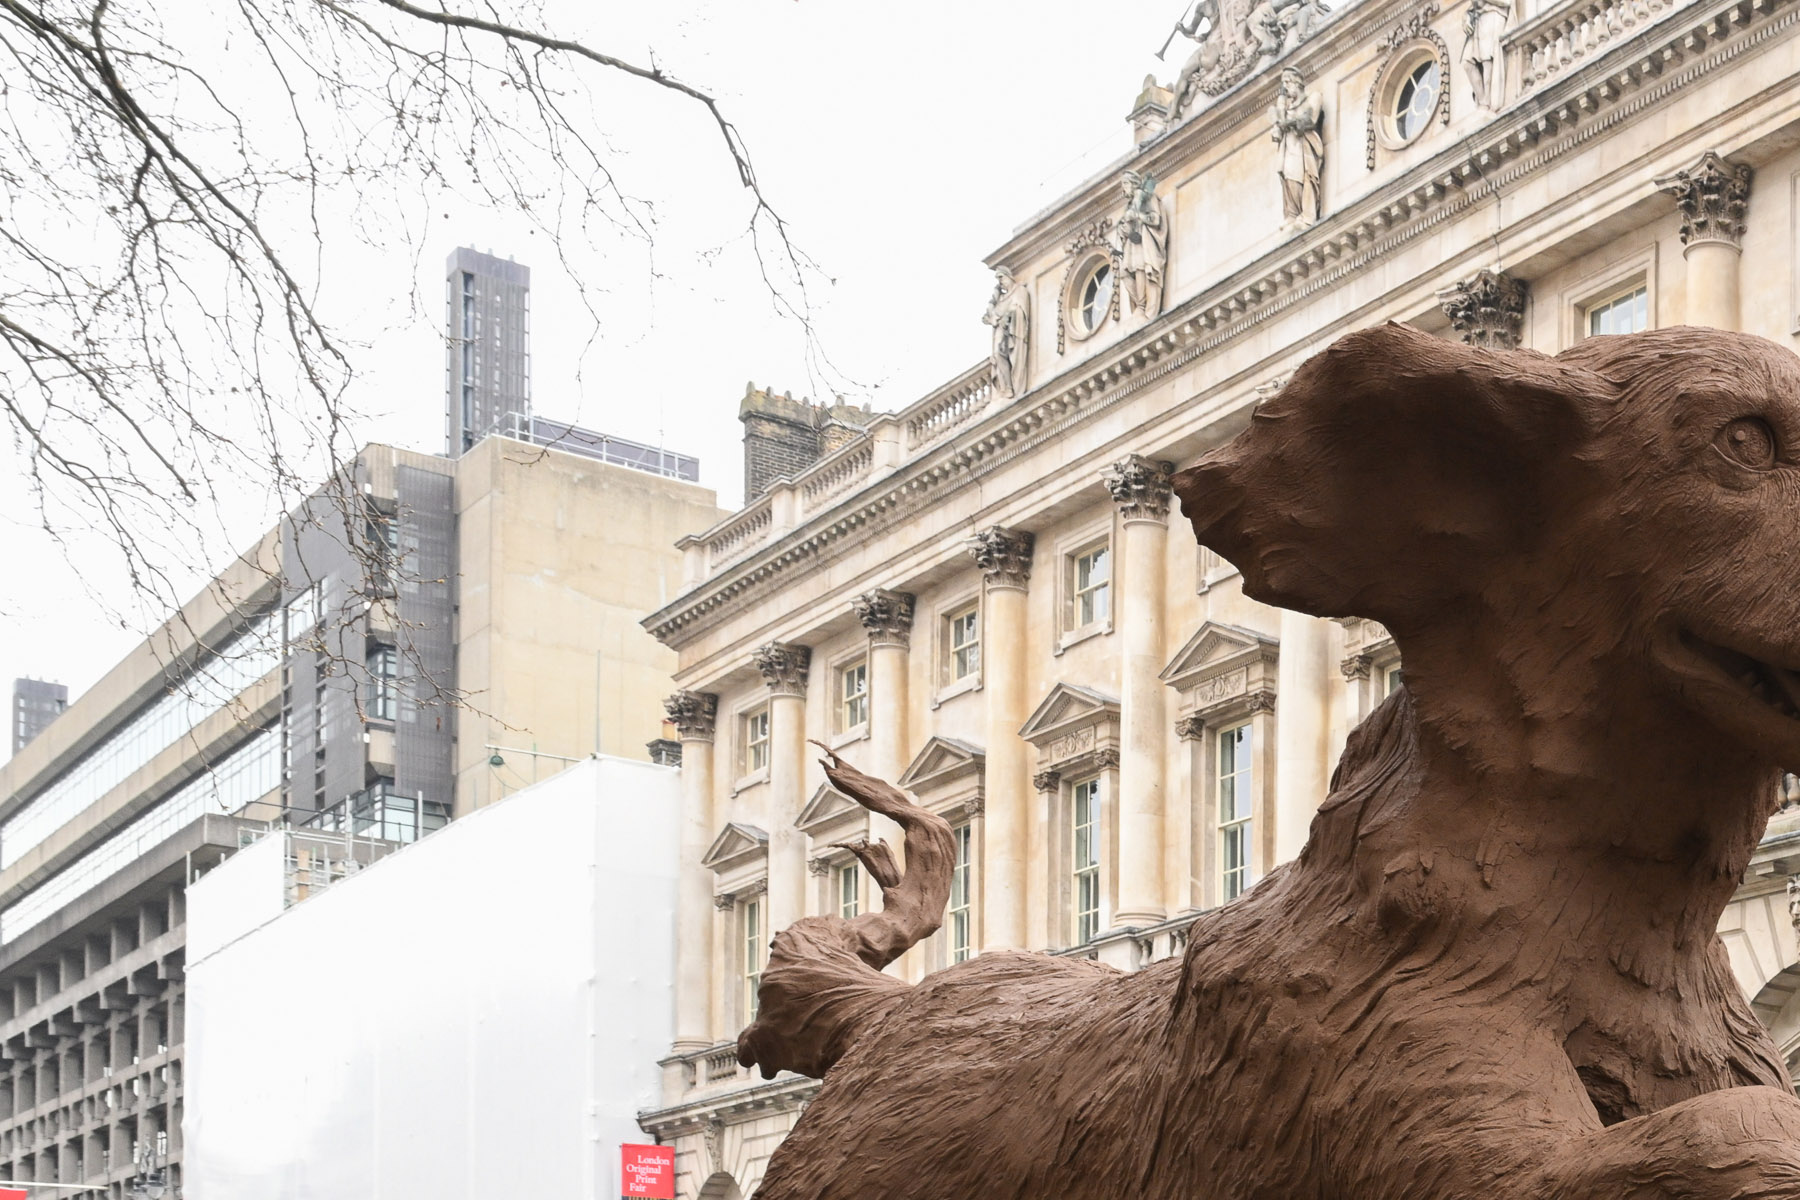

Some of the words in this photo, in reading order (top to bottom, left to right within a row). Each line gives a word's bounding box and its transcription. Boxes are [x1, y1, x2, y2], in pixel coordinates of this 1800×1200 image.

[637, 1155, 670, 1166] London
[626, 1163, 661, 1176] Original
[635, 1174, 657, 1184] Print
[629, 1182, 647, 1192] Fair
